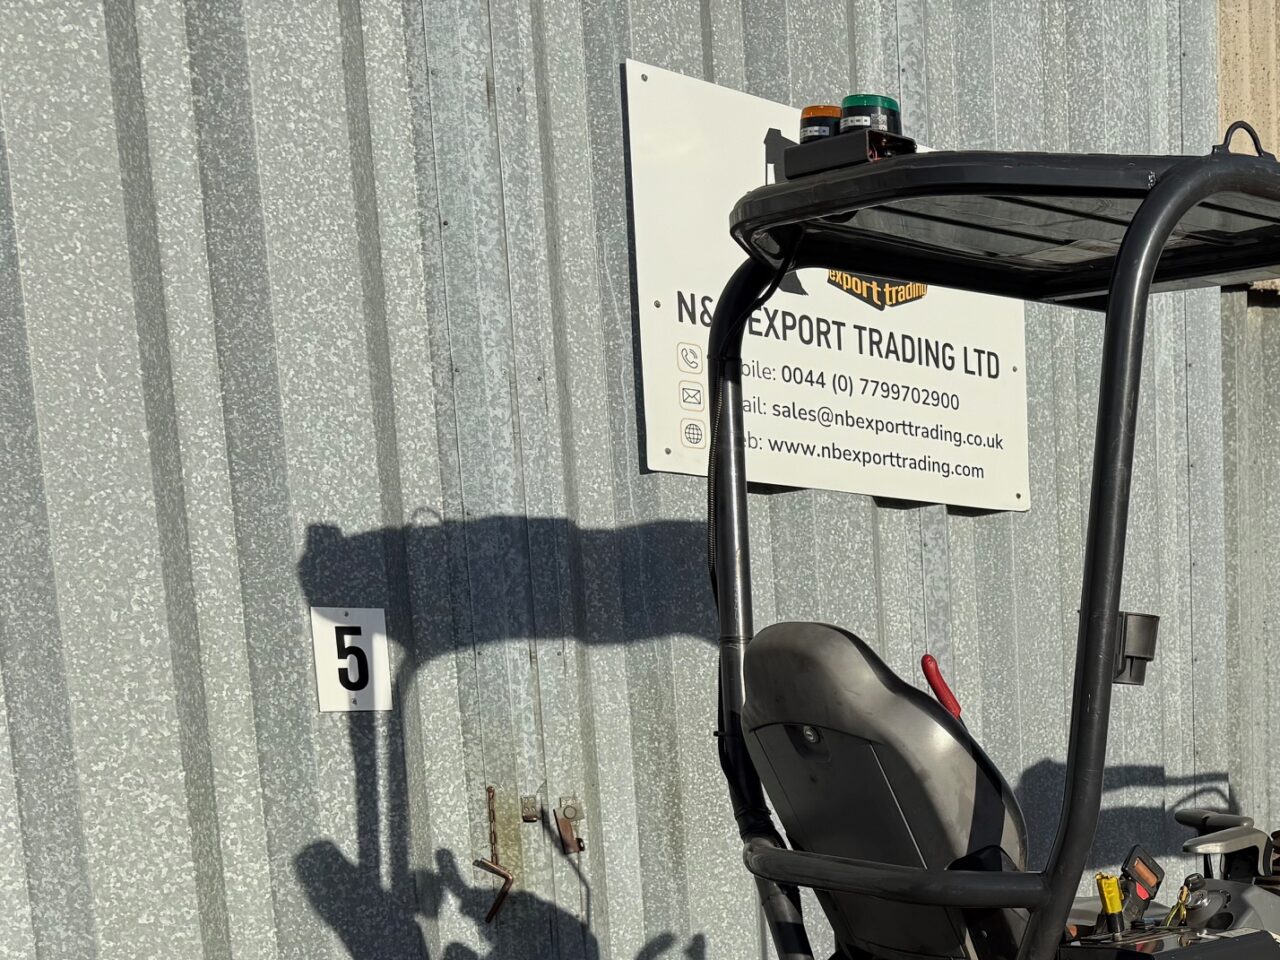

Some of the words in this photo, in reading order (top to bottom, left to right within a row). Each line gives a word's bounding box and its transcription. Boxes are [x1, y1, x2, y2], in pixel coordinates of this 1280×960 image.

[829, 269, 882, 305] export
[676, 290, 714, 328] N&
[748, 306, 846, 352] EXPORT
[853, 324, 956, 371] TRADING
[963, 346, 1000, 379] LTD
[741, 360, 776, 381] bile:
[781, 365, 827, 388] 0044
[832, 373, 853, 397] (0)
[859, 378, 960, 411] 7799702900
[743, 396, 766, 415] ail:
[772, 402, 1004, 450] sales@nbexporttrading.co.uk
[768, 439, 985, 478] www.nbexporttrading.com
[335, 626, 369, 691] 5
